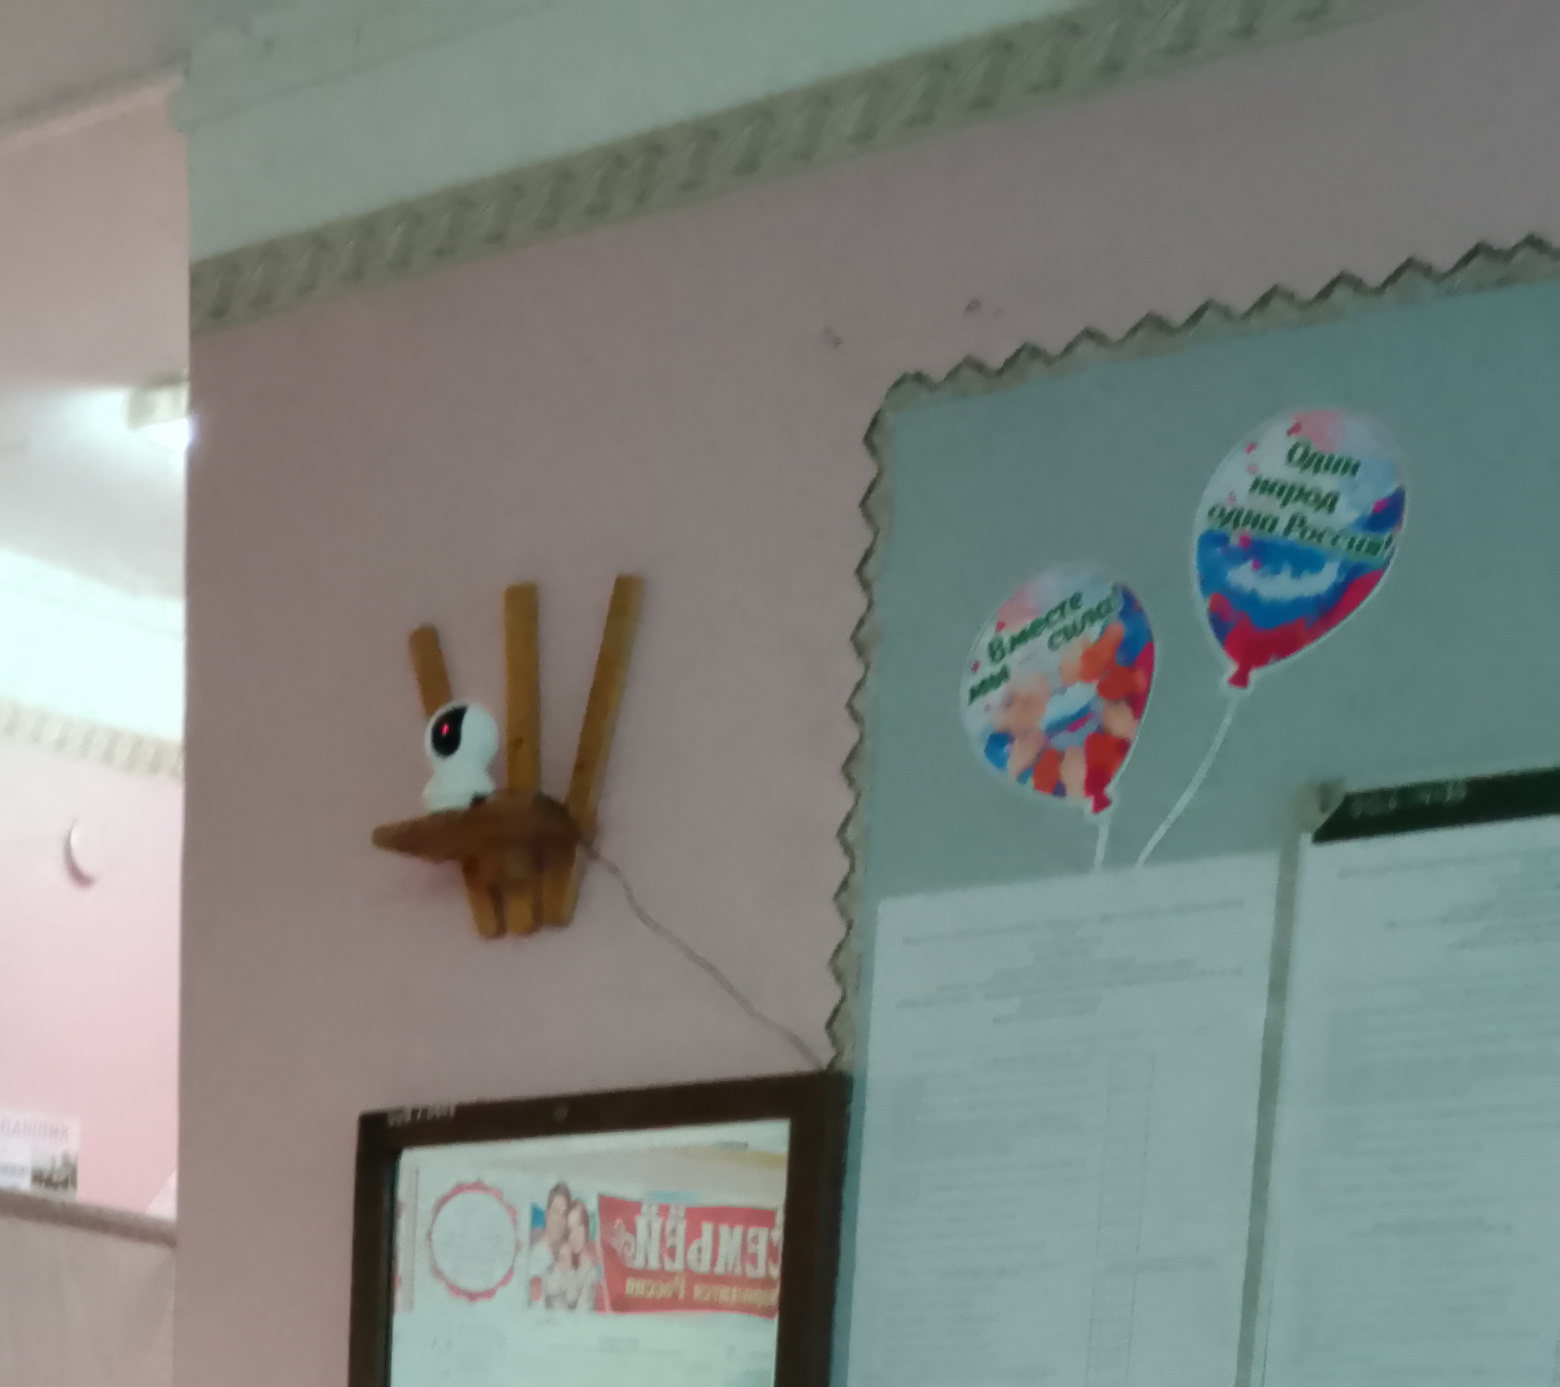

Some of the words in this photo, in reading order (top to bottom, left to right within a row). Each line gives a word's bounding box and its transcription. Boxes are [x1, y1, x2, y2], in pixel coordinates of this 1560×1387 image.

[1286, 440, 1361, 478] Один
[1249, 474, 1340, 515] народ
[1207, 504, 1280, 535] одна
[987, 591, 1084, 664] Вместе
